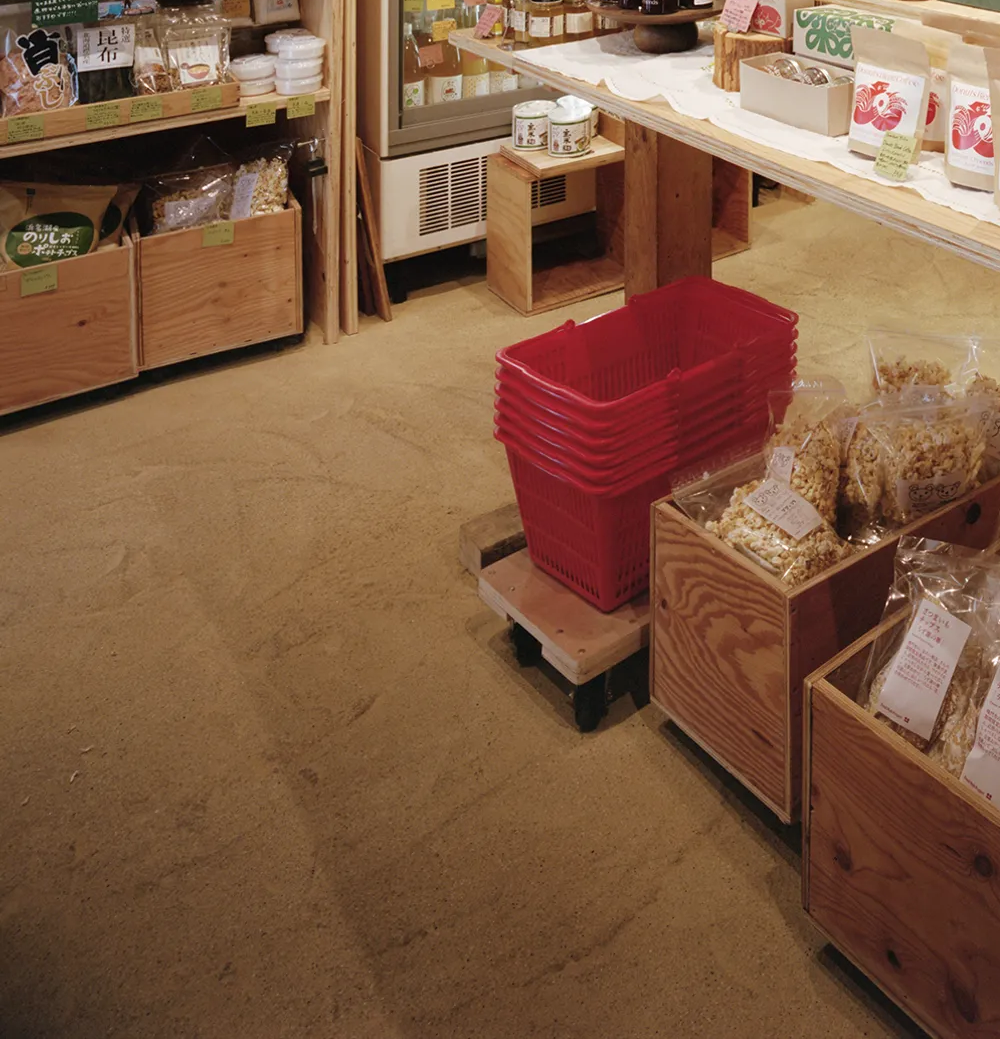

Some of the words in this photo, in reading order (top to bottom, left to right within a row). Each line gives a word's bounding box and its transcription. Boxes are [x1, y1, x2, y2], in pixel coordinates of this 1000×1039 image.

[97, 29, 118, 64] 昆布
[23, 231, 74, 245] のりしお
[31, 243, 79, 257] ポテトチップス
[923, 608, 951, 629] さつまいも
